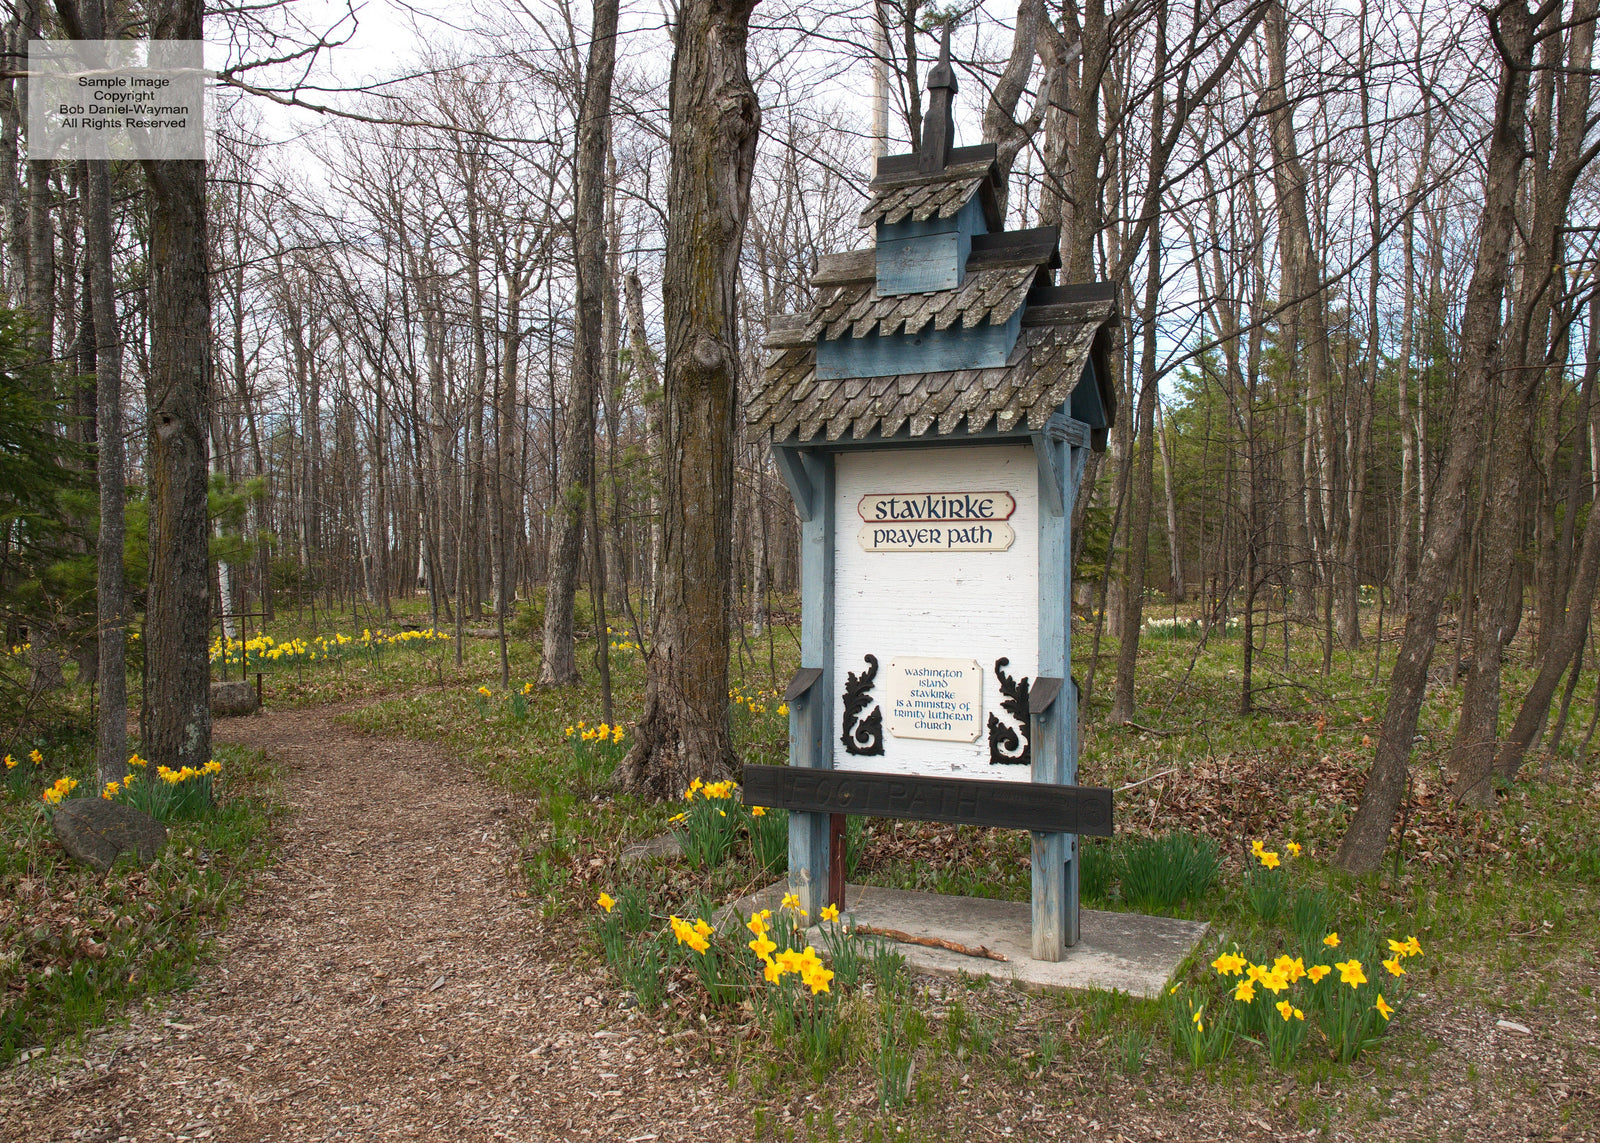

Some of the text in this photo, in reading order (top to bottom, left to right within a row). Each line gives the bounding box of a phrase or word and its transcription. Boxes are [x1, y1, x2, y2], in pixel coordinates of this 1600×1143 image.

[947, 525, 993, 548] path
[958, 701, 971, 712] of
[786, 774, 884, 809] FOOT
[886, 780, 981, 817] PATH
